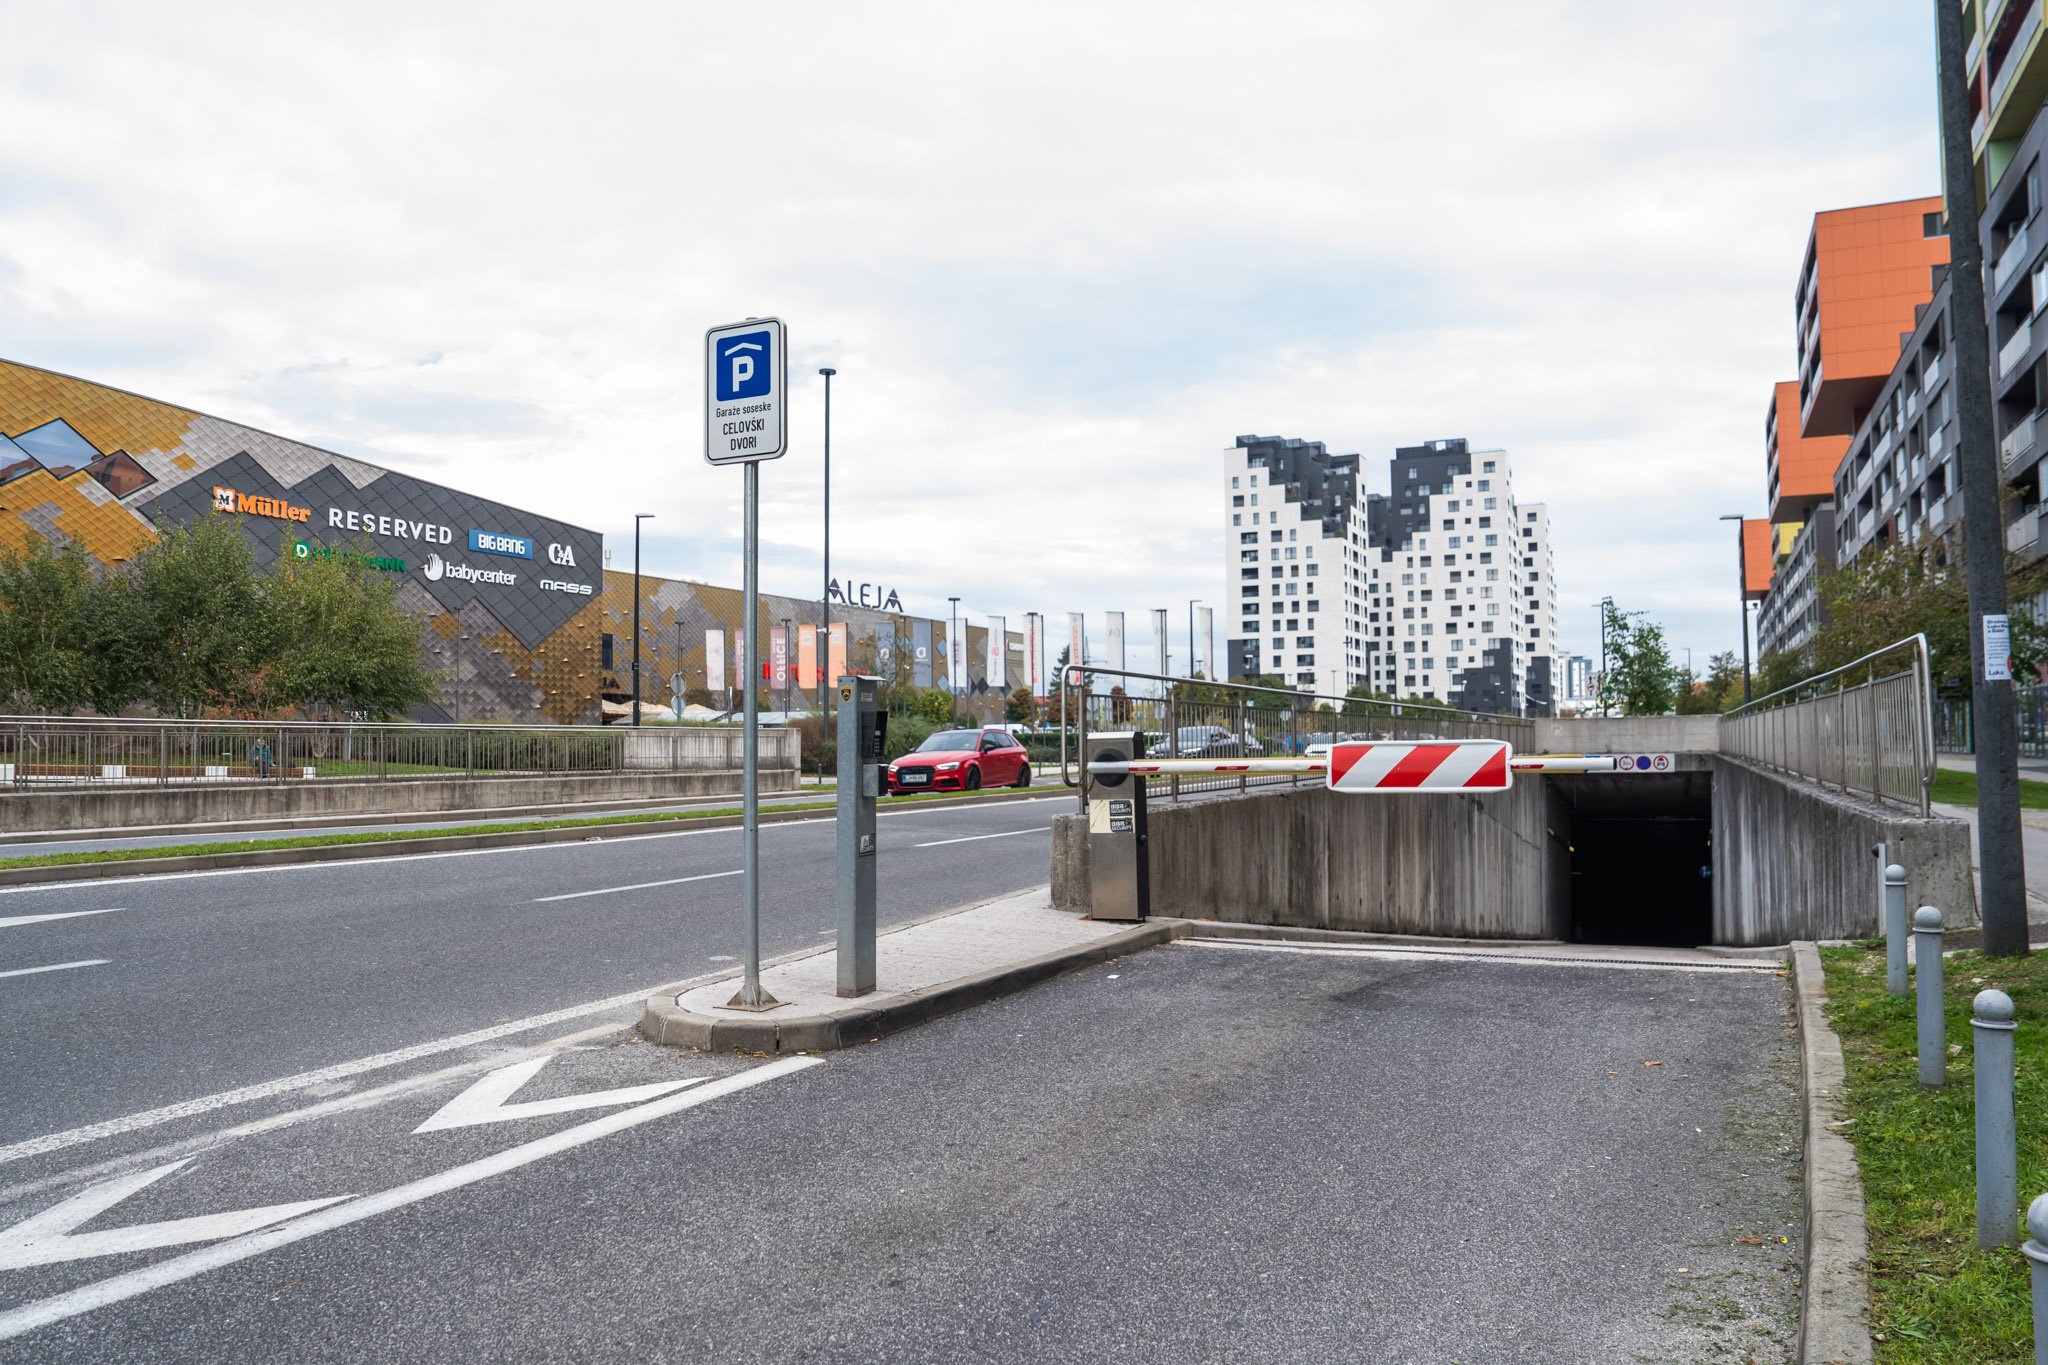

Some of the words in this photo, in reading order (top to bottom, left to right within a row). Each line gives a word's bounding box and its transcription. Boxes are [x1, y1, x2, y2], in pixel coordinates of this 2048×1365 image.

[732, 355, 754, 393] P
[716, 406, 741, 418] Garaže
[742, 402, 772, 414] soseske
[722, 417, 765, 435] CELOVŠKI
[730, 436, 757, 451] DVORI
[237, 493, 312, 523] Müller
[328, 507, 453, 545] RESERVED
[478, 533, 496, 550] BIG
[496, 537, 526, 555] BANG
[548, 542, 577, 567] C&A
[445, 561, 517, 586] babycenter
[823, 577, 904, 613] ALEJA
